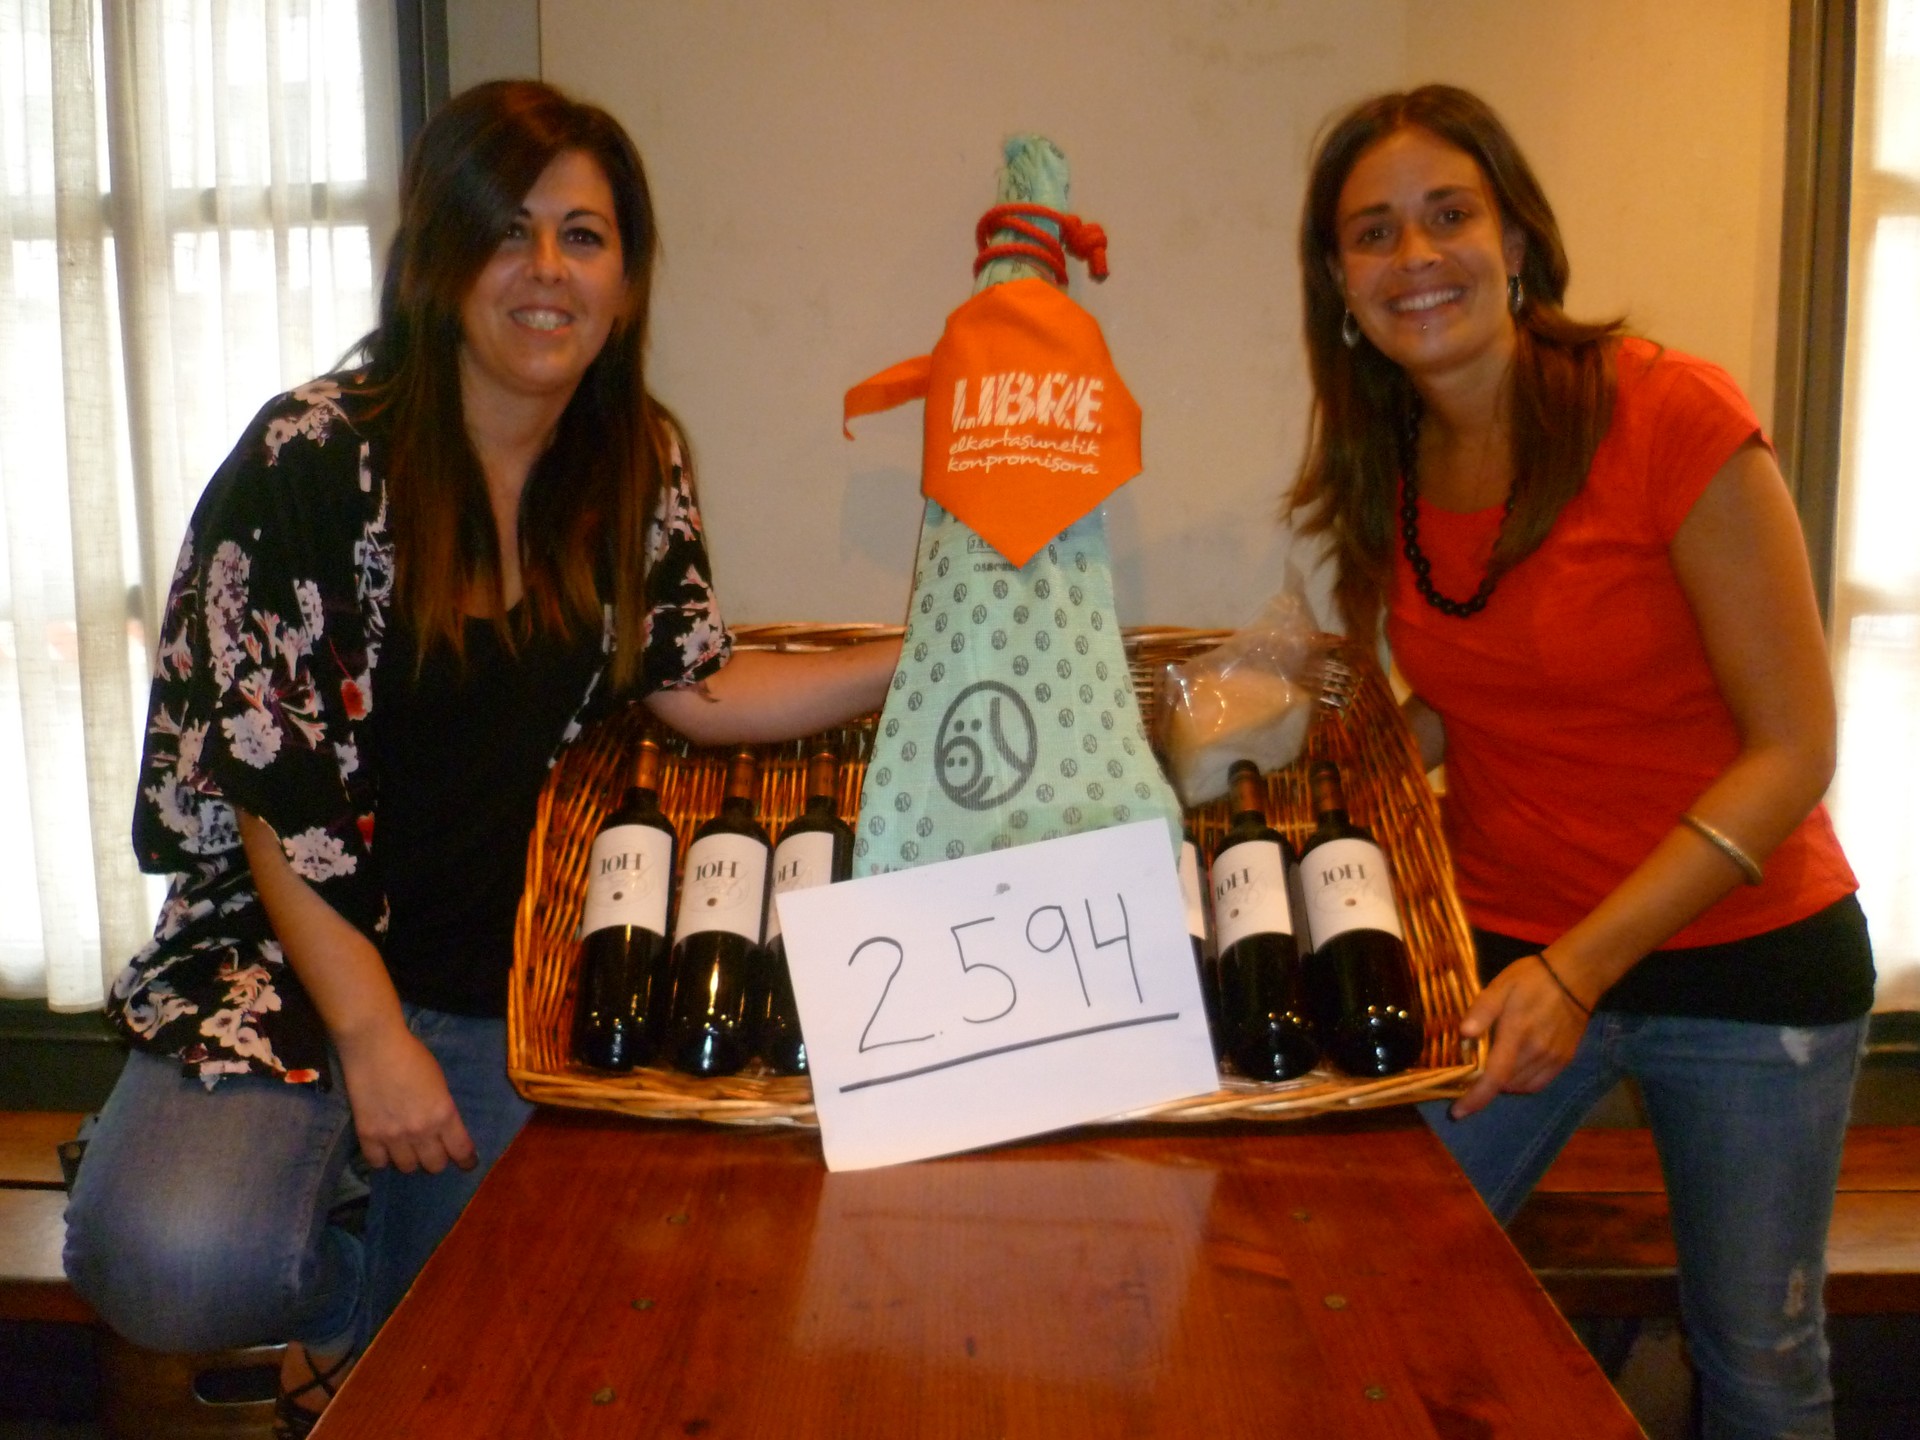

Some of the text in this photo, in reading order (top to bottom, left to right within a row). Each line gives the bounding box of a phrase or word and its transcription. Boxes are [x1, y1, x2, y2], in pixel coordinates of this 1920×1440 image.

[951, 371, 1104, 434] LIBRE
[949, 428, 1100, 457] elkartasunetik
[947, 453, 1099, 475] konpromisora
